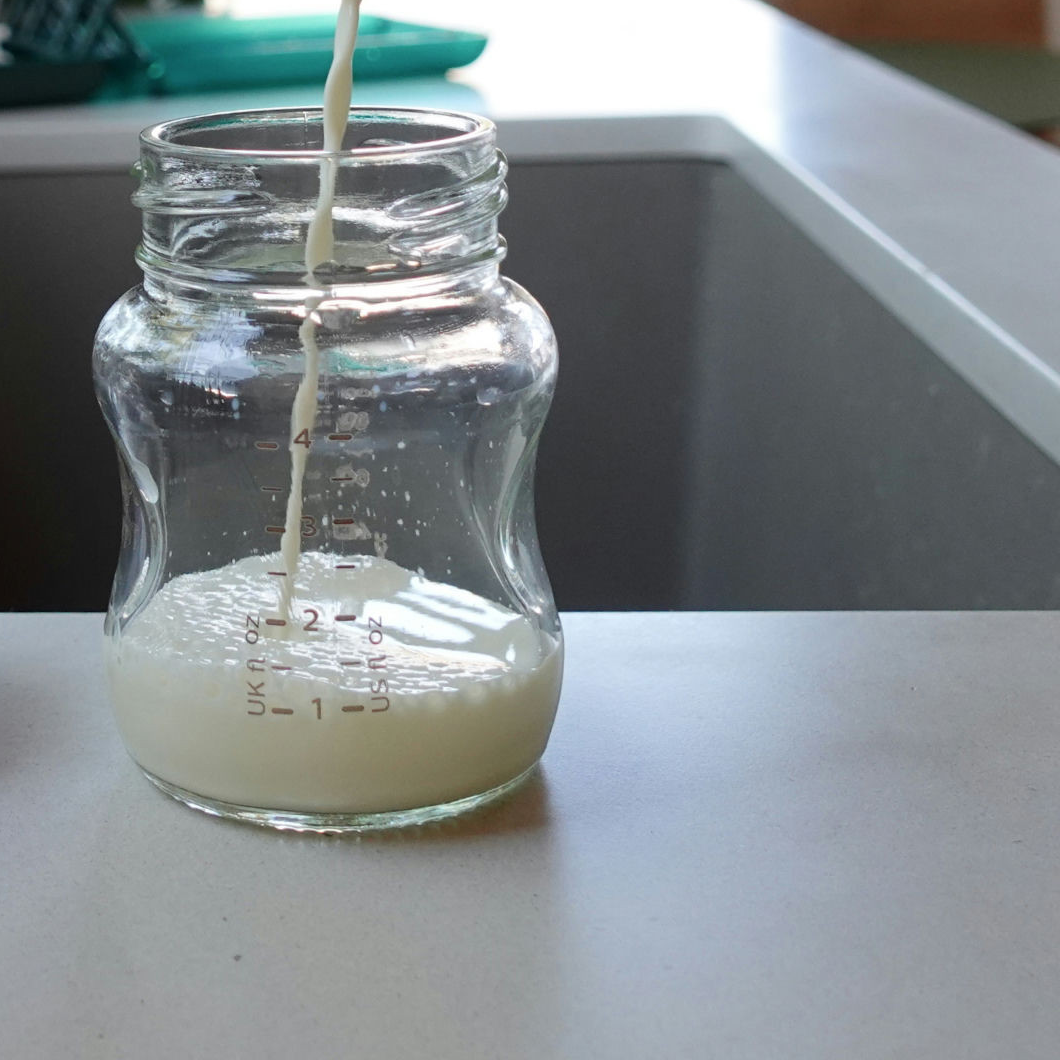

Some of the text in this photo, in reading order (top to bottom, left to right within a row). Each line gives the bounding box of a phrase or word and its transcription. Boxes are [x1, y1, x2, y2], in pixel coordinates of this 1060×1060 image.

[294, 428, 312, 449] 4
[301, 516, 317, 537] 3
[245, 615, 260, 645] oz
[303, 609, 319, 631] 2
[247, 681, 266, 716] UK
[370, 678, 390, 713] US
[311, 697, 322, 720] 1
